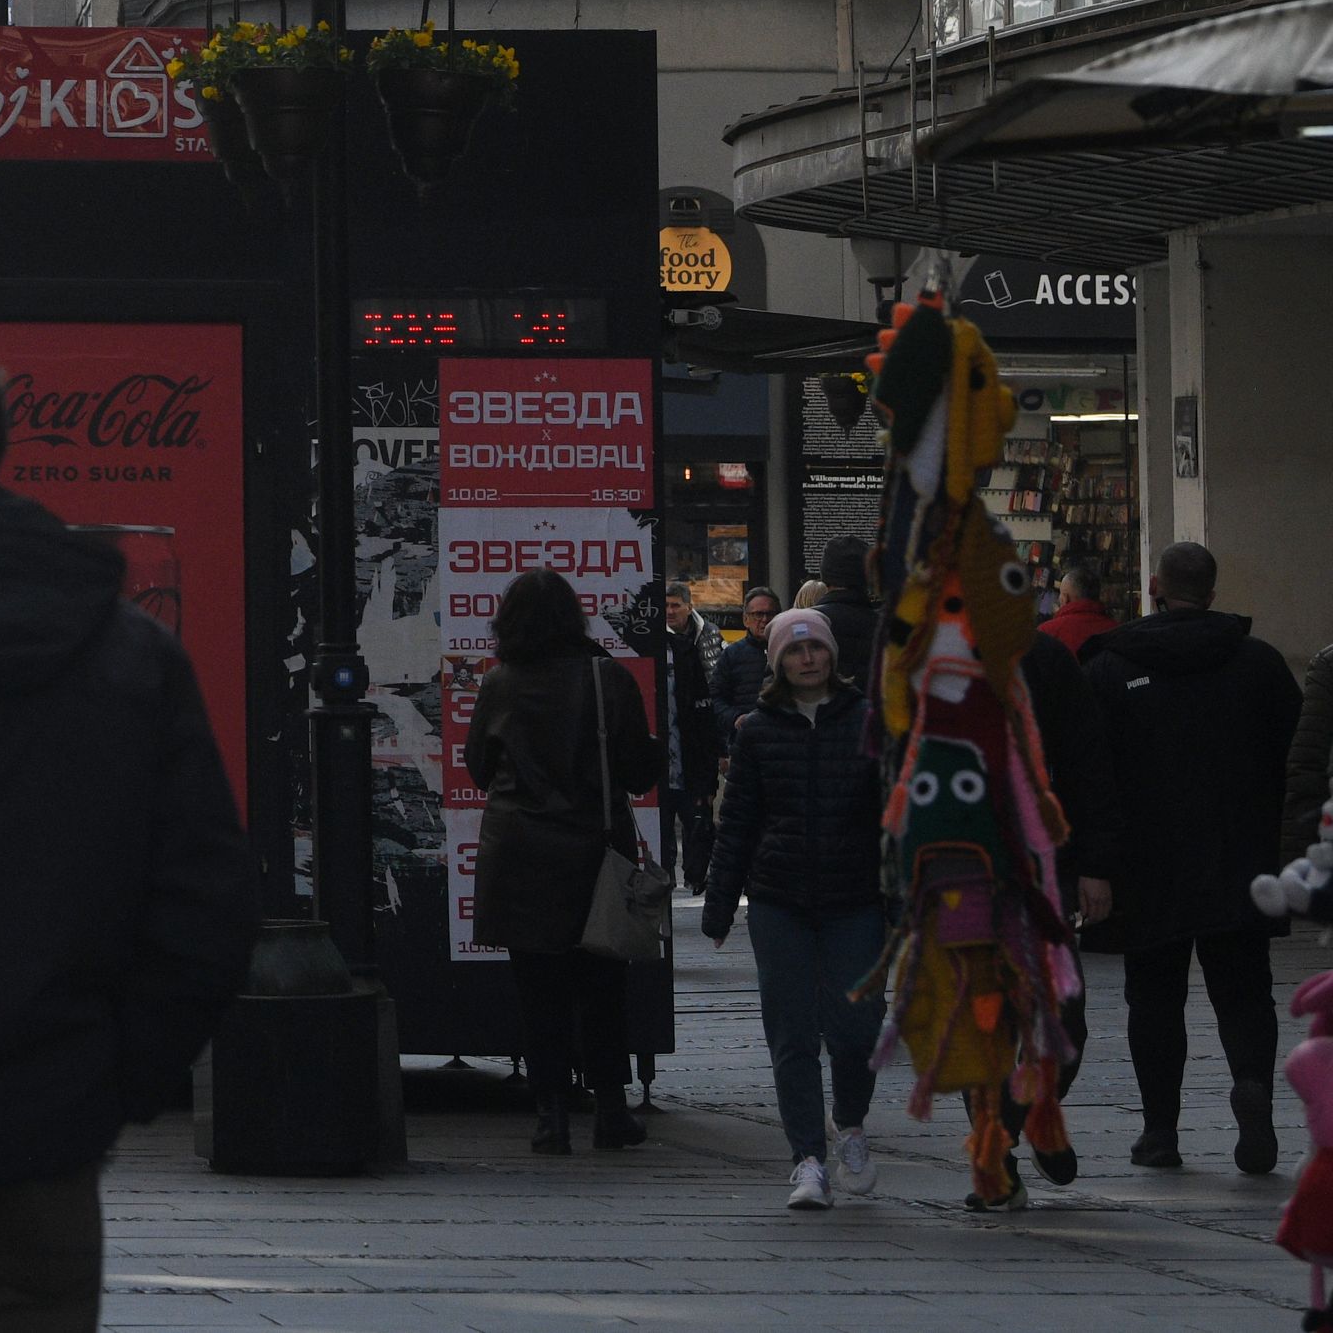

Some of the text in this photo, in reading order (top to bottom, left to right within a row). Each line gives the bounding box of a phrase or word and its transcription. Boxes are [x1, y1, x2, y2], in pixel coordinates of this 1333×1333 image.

[676, 233, 700, 250] The
[660, 247, 716, 268] food
[659, 267, 721, 289] story
[2, 373, 215, 449] Coca-Cola
[448, 392, 644, 429] ЗВЕЗДА
[449, 445, 645, 471] ВОЖДОВАЦ
[13, 466, 174, 482] ZERO SUGAR
[448, 541, 644, 578] ЗВЕЗДА
